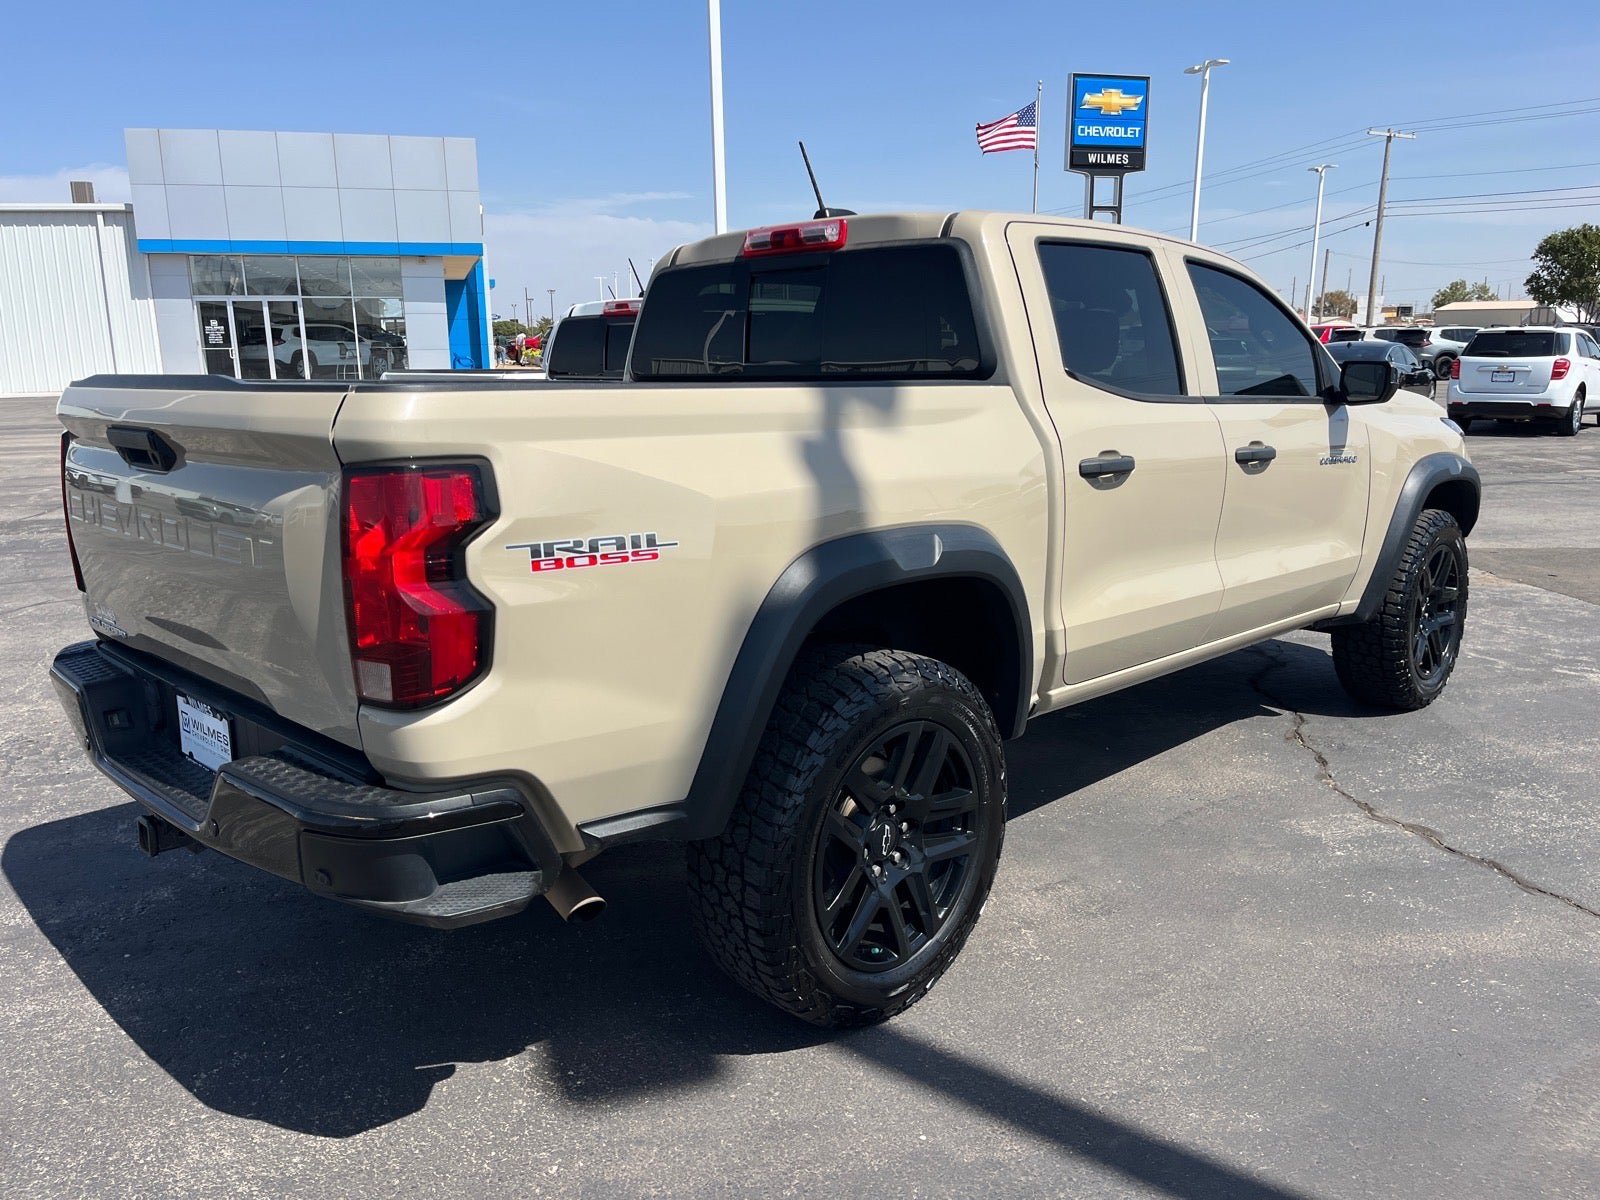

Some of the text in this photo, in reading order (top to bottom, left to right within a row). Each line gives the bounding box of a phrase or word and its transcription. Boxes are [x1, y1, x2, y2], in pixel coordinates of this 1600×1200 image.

[1078, 126, 1141, 138] CHEVROLET
[1088, 153, 1129, 164] WILMES
[505, 533, 679, 560] TRAIL
[531, 548, 659, 573] BOSS
[191, 717, 228, 746] WILMES
